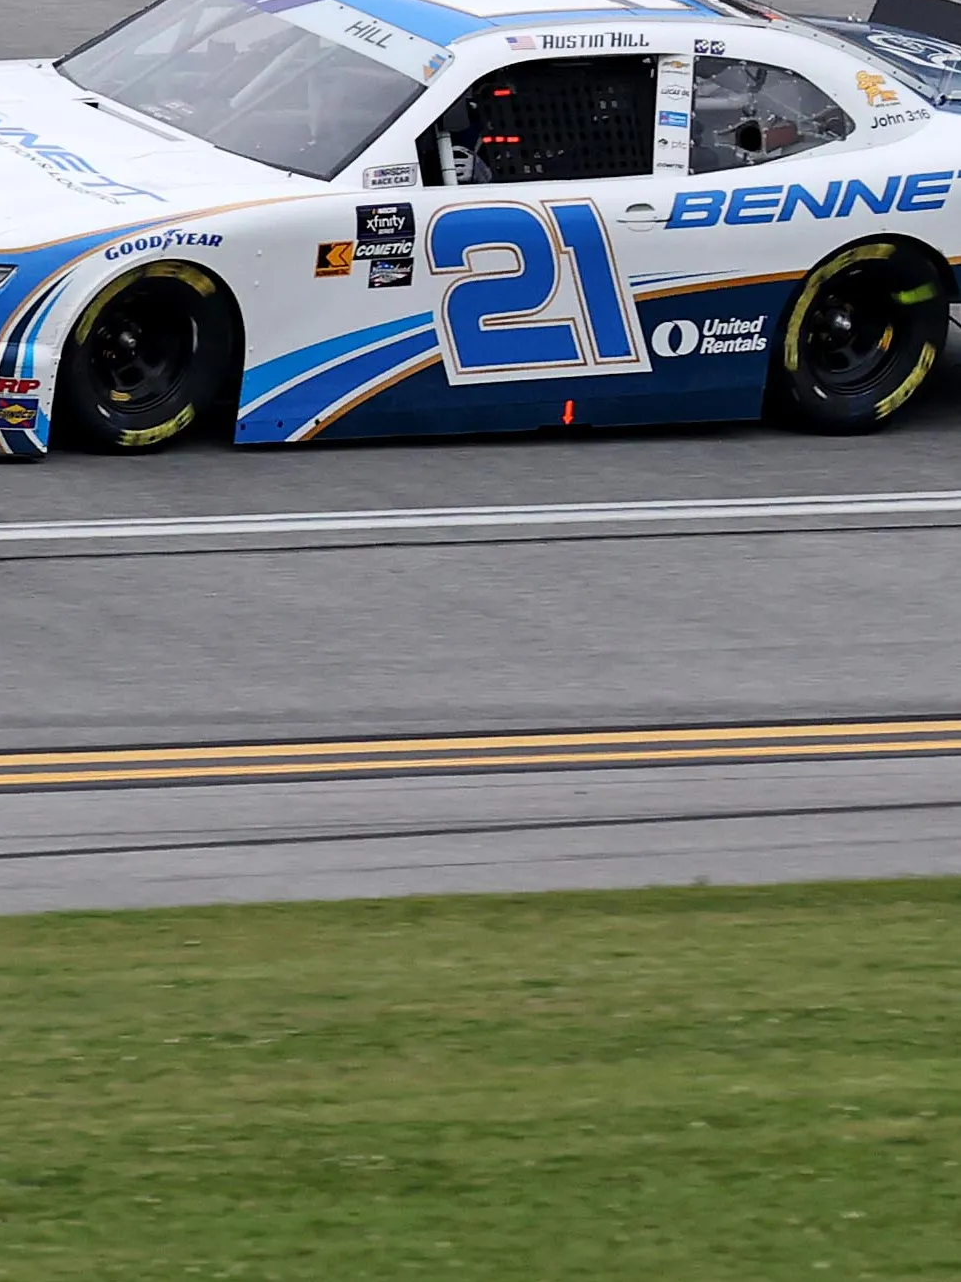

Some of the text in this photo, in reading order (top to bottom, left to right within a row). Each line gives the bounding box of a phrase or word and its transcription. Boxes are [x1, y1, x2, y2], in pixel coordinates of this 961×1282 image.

[343, 20, 393, 49] HILL
[536, 32, 650, 49] AUSTIN HILL
[870, 112, 905, 129] John
[371, 175, 410, 186] RACE CAR
[665, 170, 961, 230] BENNE
[366, 214, 405, 232] xfinity
[426, 199, 639, 375] 21
[702, 316, 764, 336] United
[700, 333, 767, 355] Rentals
